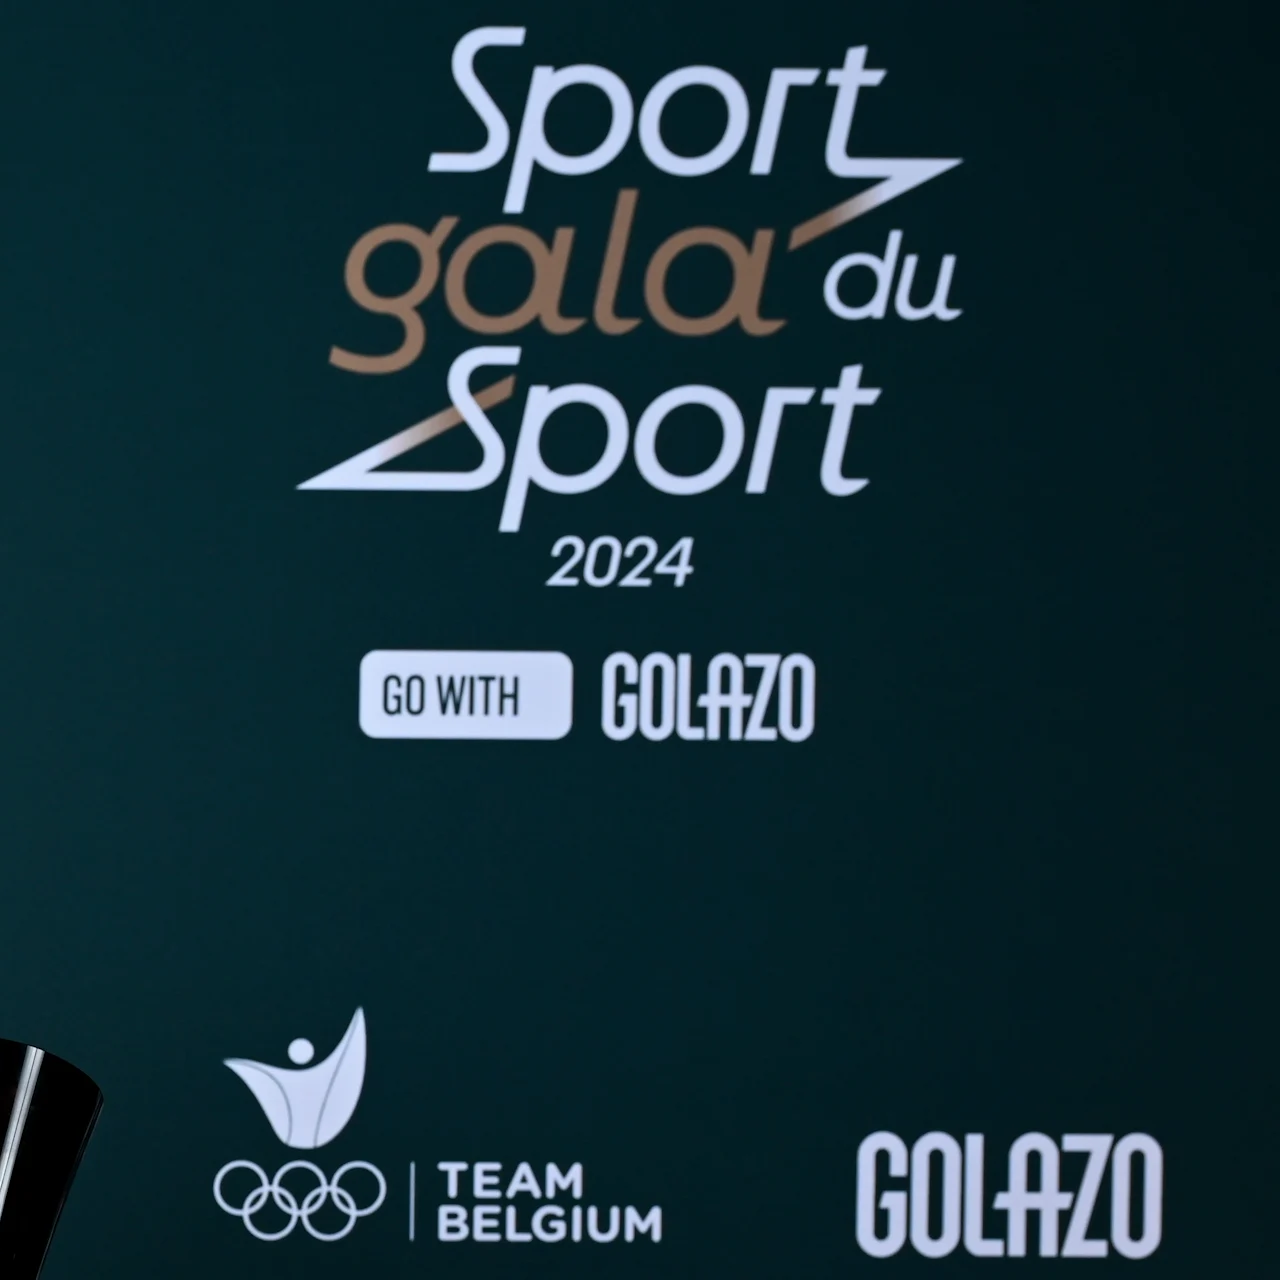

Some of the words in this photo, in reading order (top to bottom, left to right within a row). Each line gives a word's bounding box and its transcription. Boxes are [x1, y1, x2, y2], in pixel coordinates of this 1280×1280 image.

[427, 26, 963, 214] Sport
[327, 187, 786, 376] gala
[823, 232, 961, 320] du
[296, 346, 882, 532] Sport
[546, 536, 693, 587] 2024
[383, 674, 425, 716] GO
[437, 676, 519, 716] WITH
[602, 652, 815, 742] GOLAZO
[438, 1162, 583, 1199] TEAM
[438, 1205, 662, 1242] BELGIUM
[856, 1131, 1163, 1259] GOLAZO
